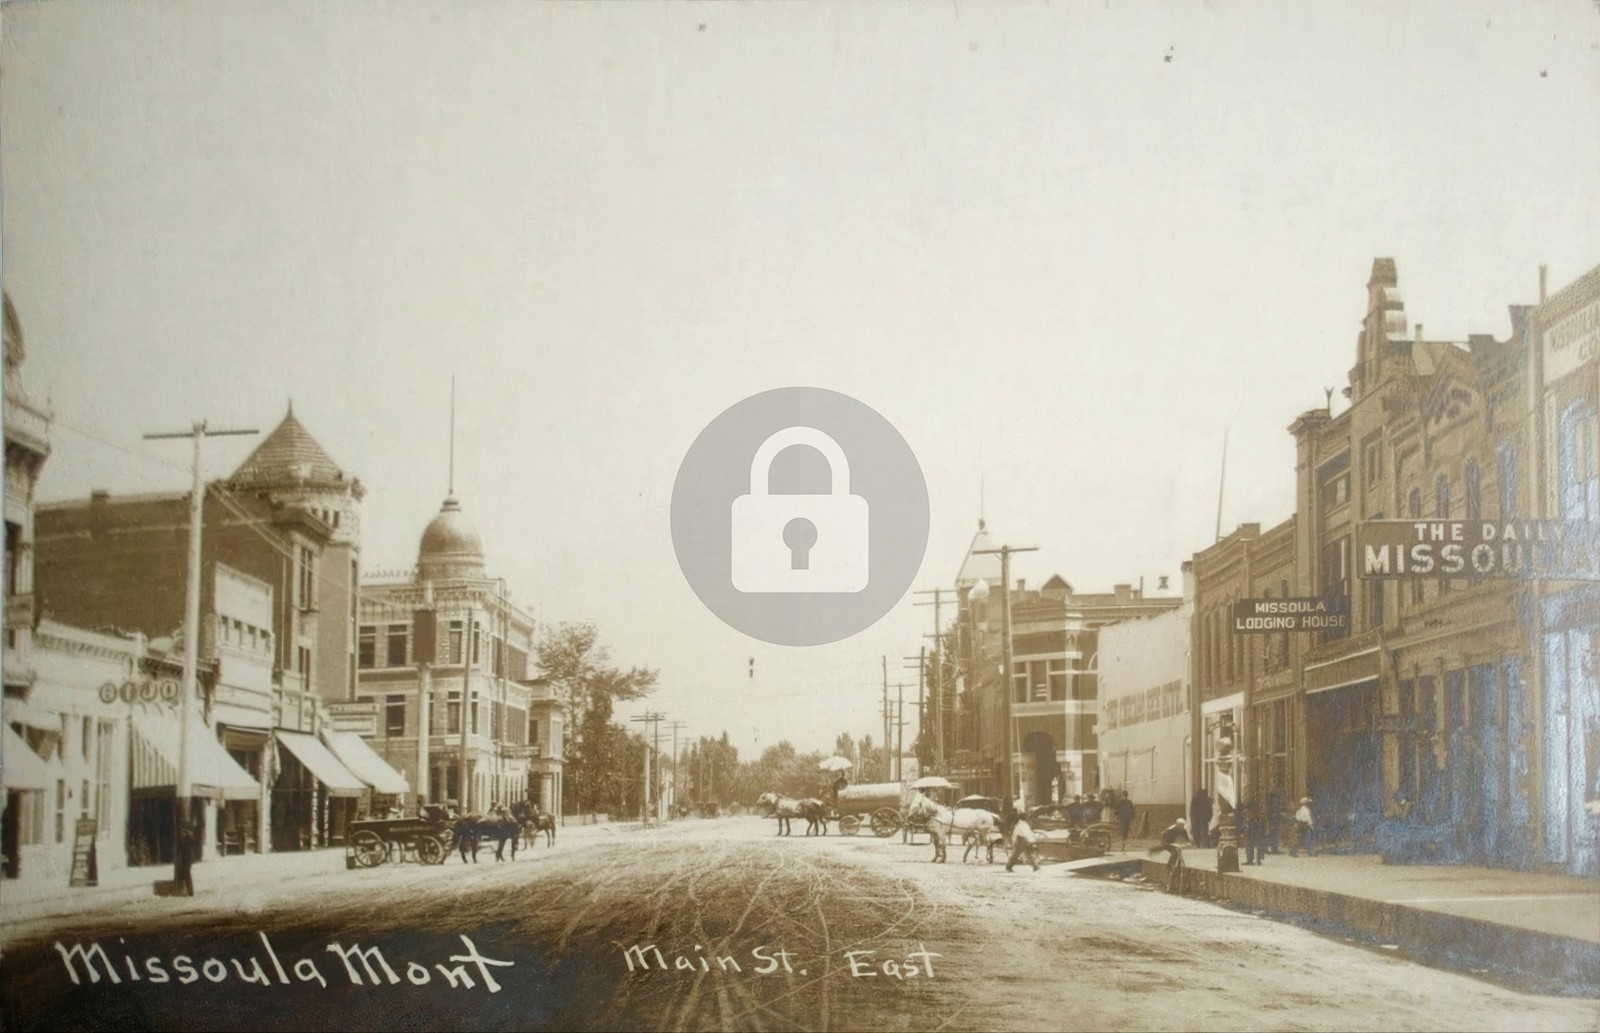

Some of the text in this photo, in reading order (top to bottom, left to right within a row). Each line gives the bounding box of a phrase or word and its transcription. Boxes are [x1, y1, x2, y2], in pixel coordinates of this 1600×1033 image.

[1414, 523, 1564, 541] THE DAILY
[1255, 602, 1327, 614] MISSOULA
[1236, 615, 1346, 630] LODGING HOUSE
[98, 680, 181, 704] BIJO
